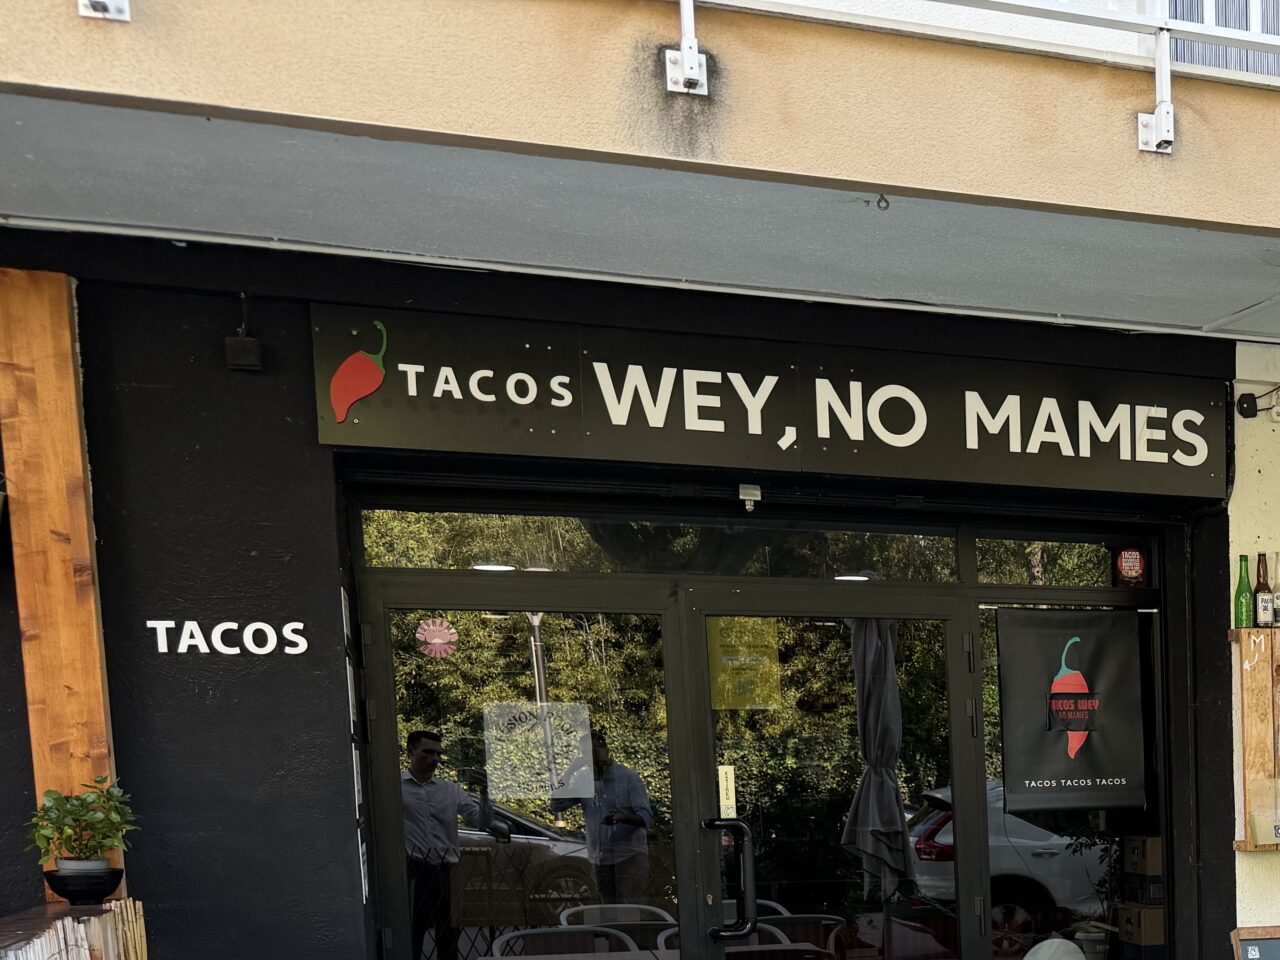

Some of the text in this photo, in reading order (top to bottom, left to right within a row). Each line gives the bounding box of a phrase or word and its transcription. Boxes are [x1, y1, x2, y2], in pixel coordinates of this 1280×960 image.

[398, 362, 1209, 467] TACOS WEY, NO MAMES
[146, 620, 309, 655] TACOS
[1025, 778, 1127, 788] TACOS TACOS TACOS
